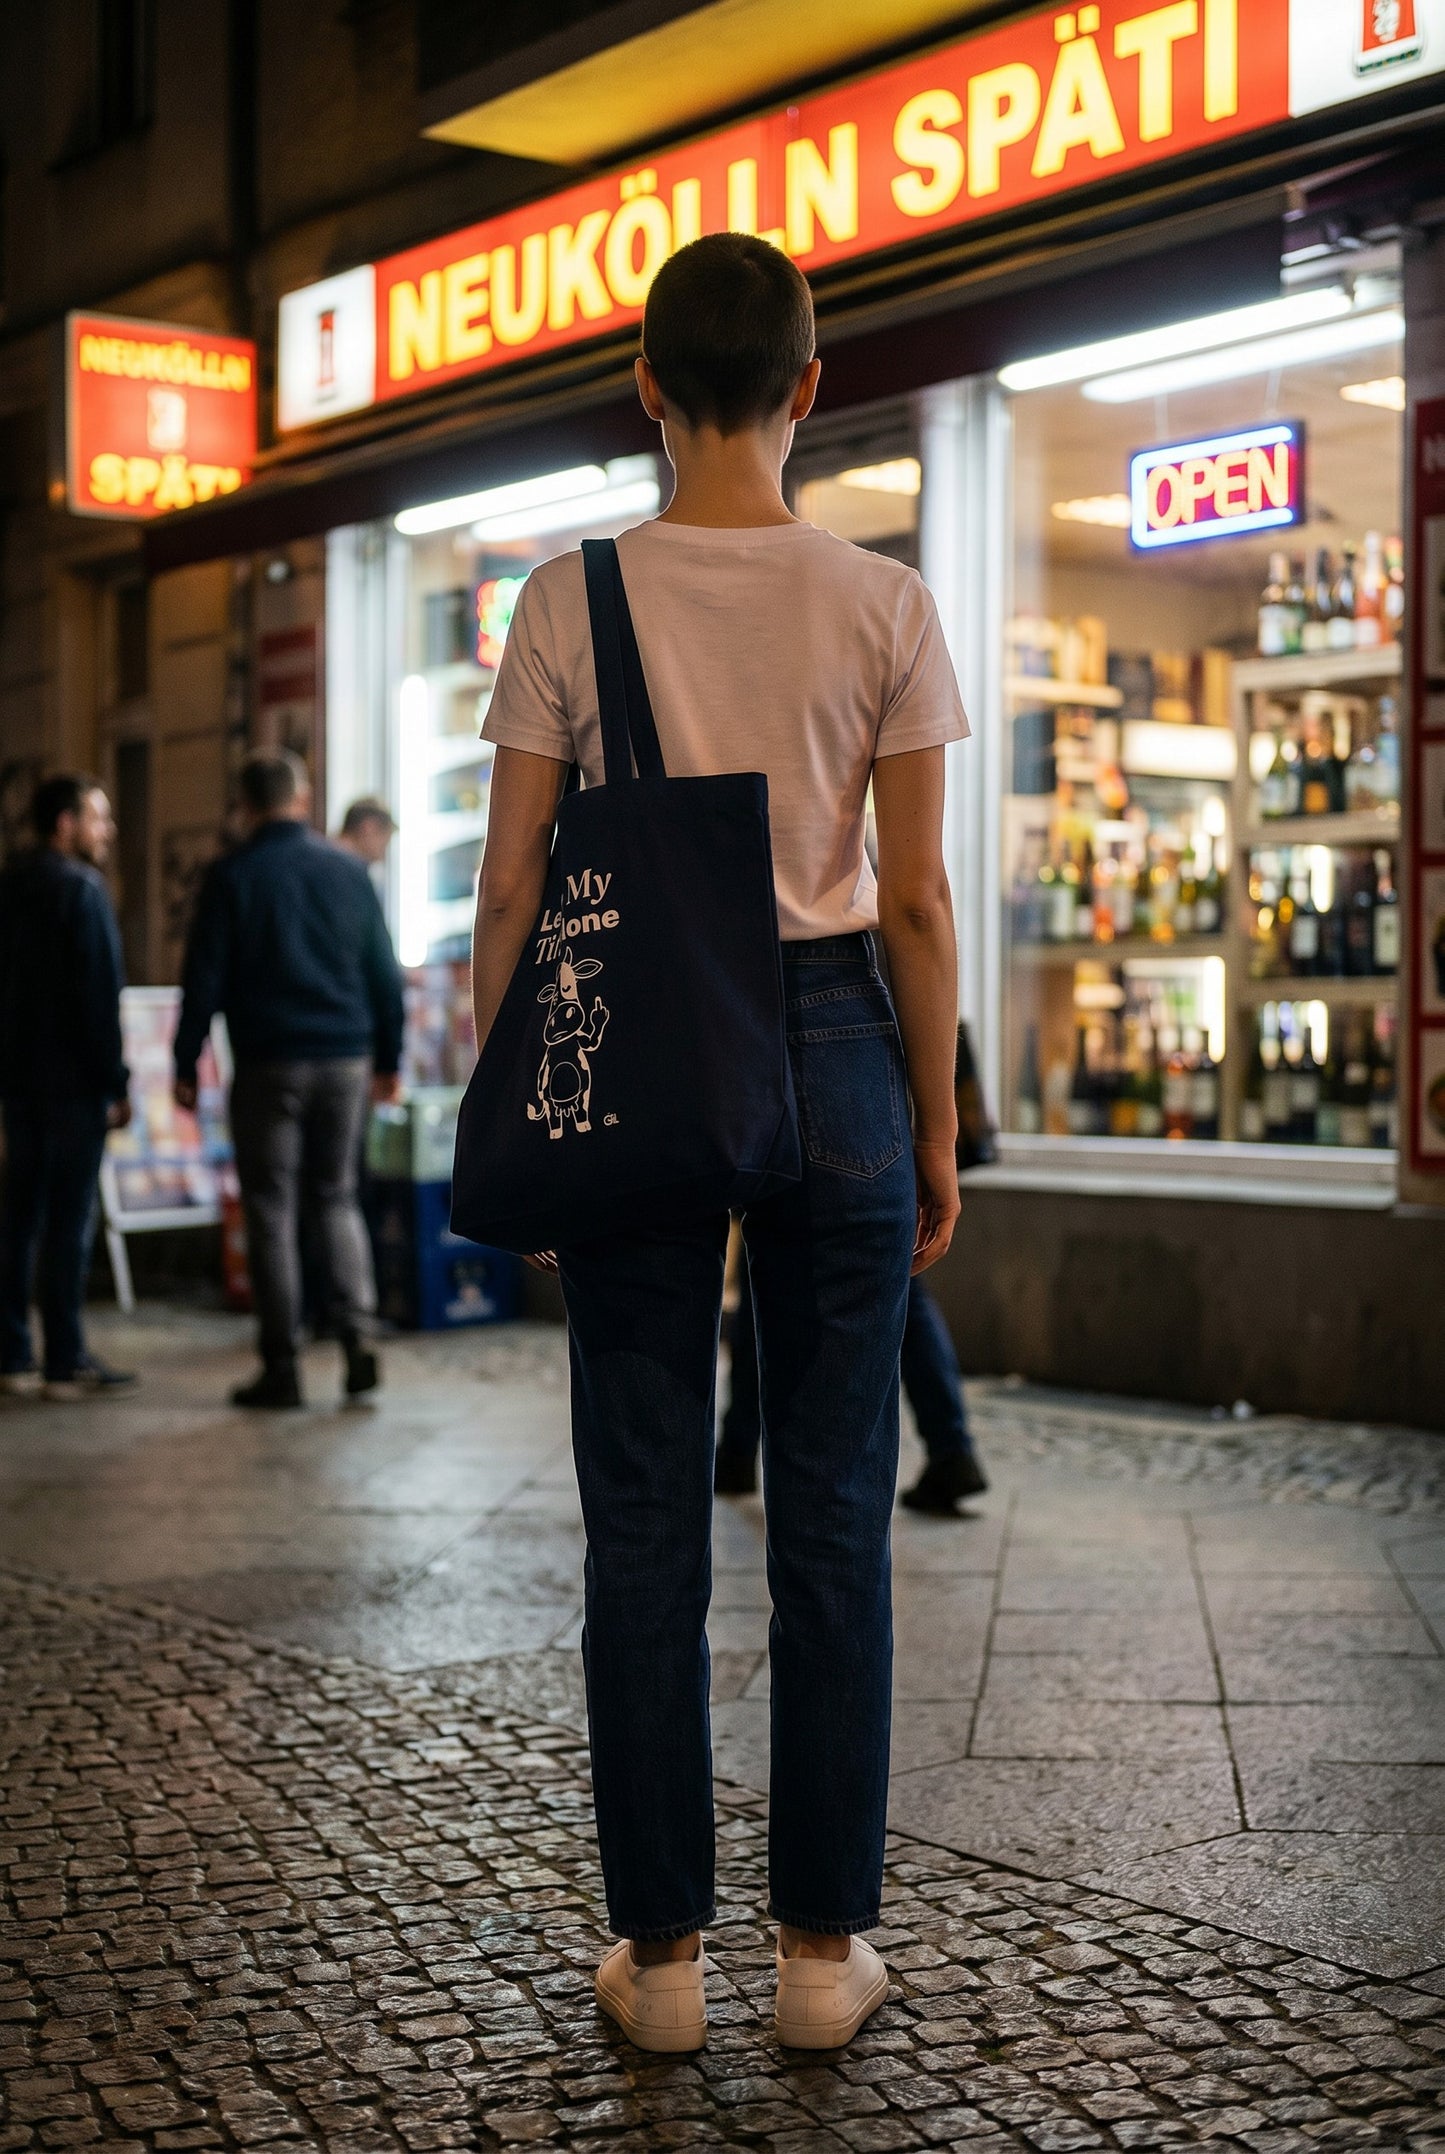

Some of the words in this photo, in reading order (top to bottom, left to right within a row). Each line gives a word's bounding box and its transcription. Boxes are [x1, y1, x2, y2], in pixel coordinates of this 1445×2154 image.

[891, 0, 1238, 218] SPÄTI
[79, 334, 251, 393] NEUKÖLLN
[1146, 442, 1290, 530] OPEN
[566, 868, 612, 905] My
